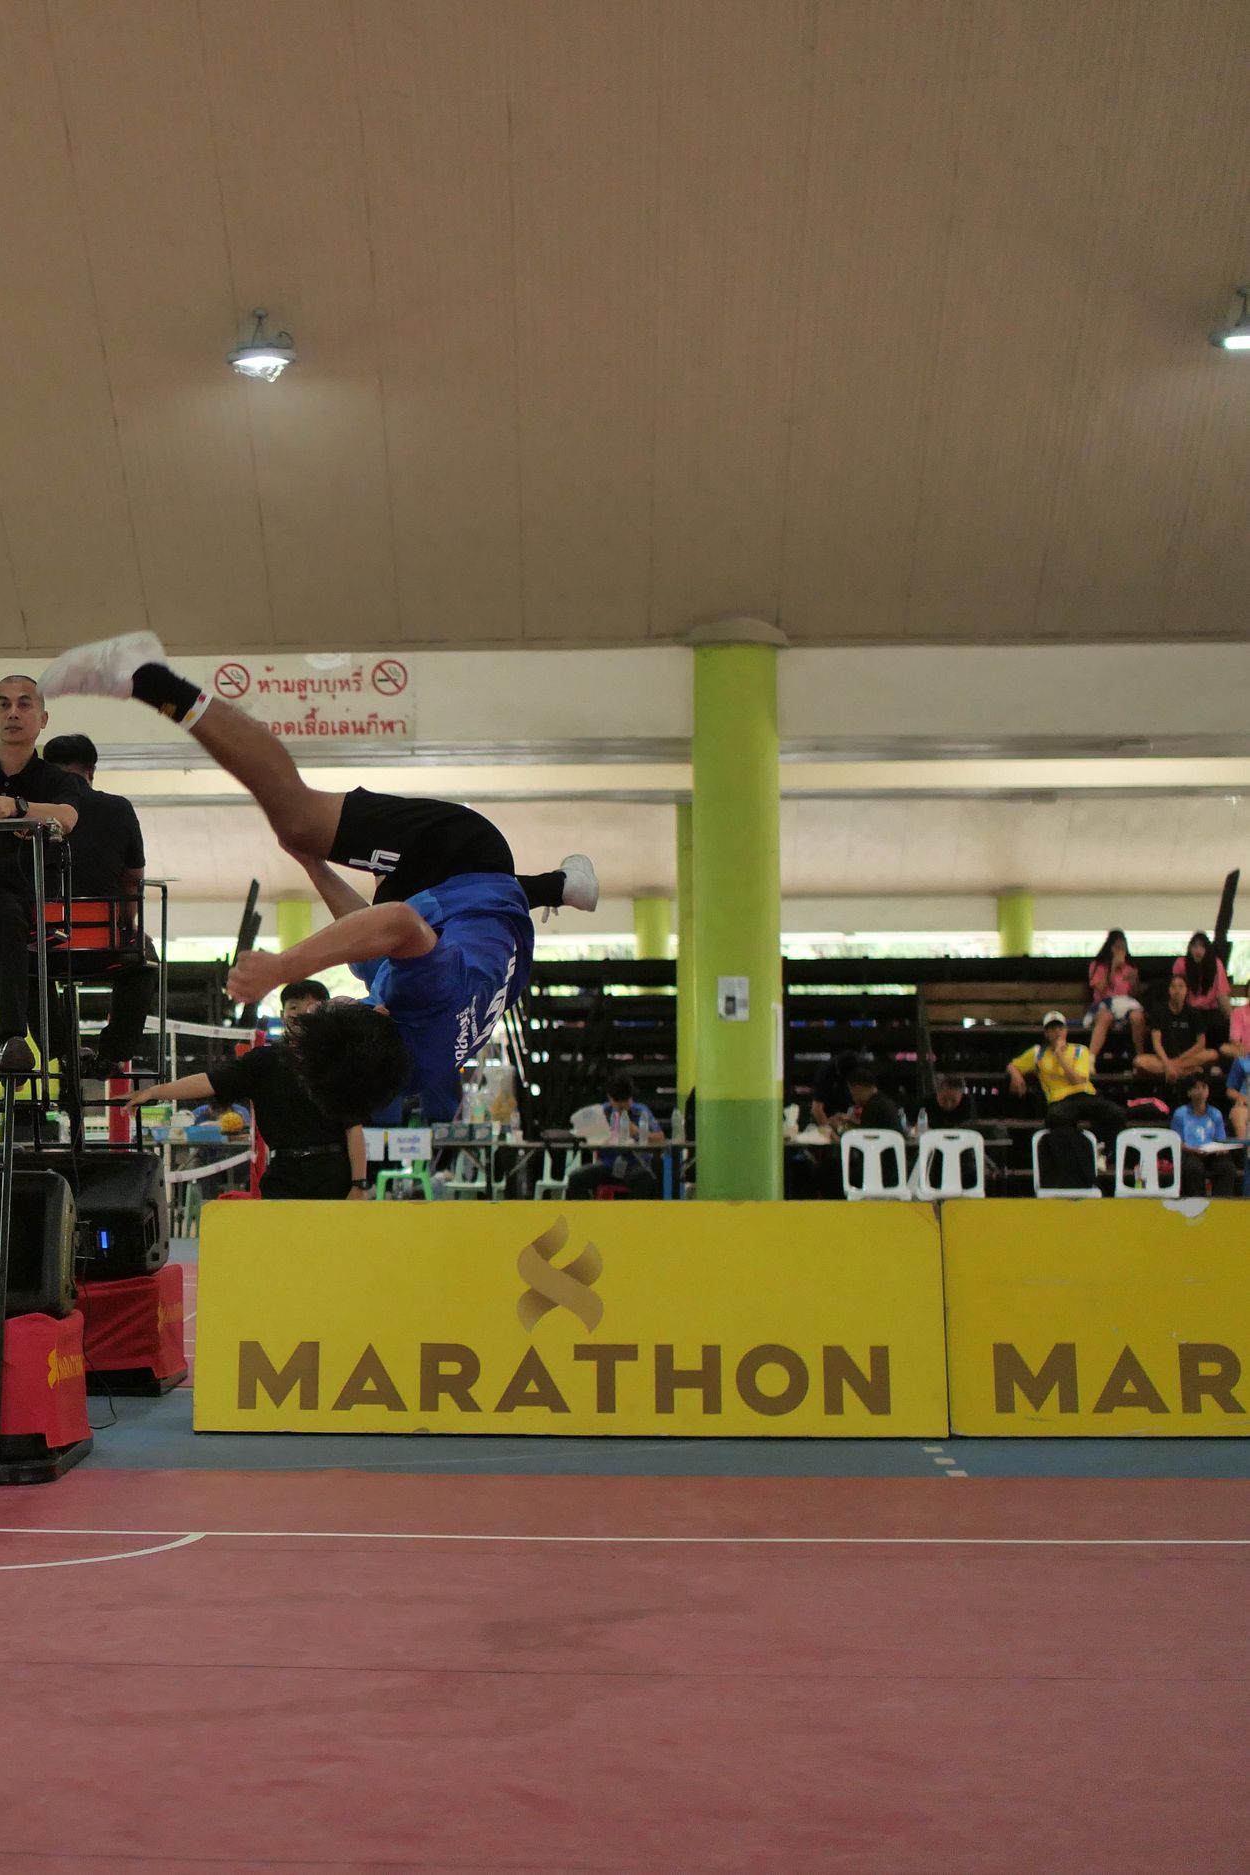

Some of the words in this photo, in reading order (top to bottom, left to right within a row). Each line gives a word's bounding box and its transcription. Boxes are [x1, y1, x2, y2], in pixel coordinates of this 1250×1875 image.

[256, 665, 364, 700] ห้ามสูบบุหรี่
[237, 1340, 892, 1417] MARATHON
